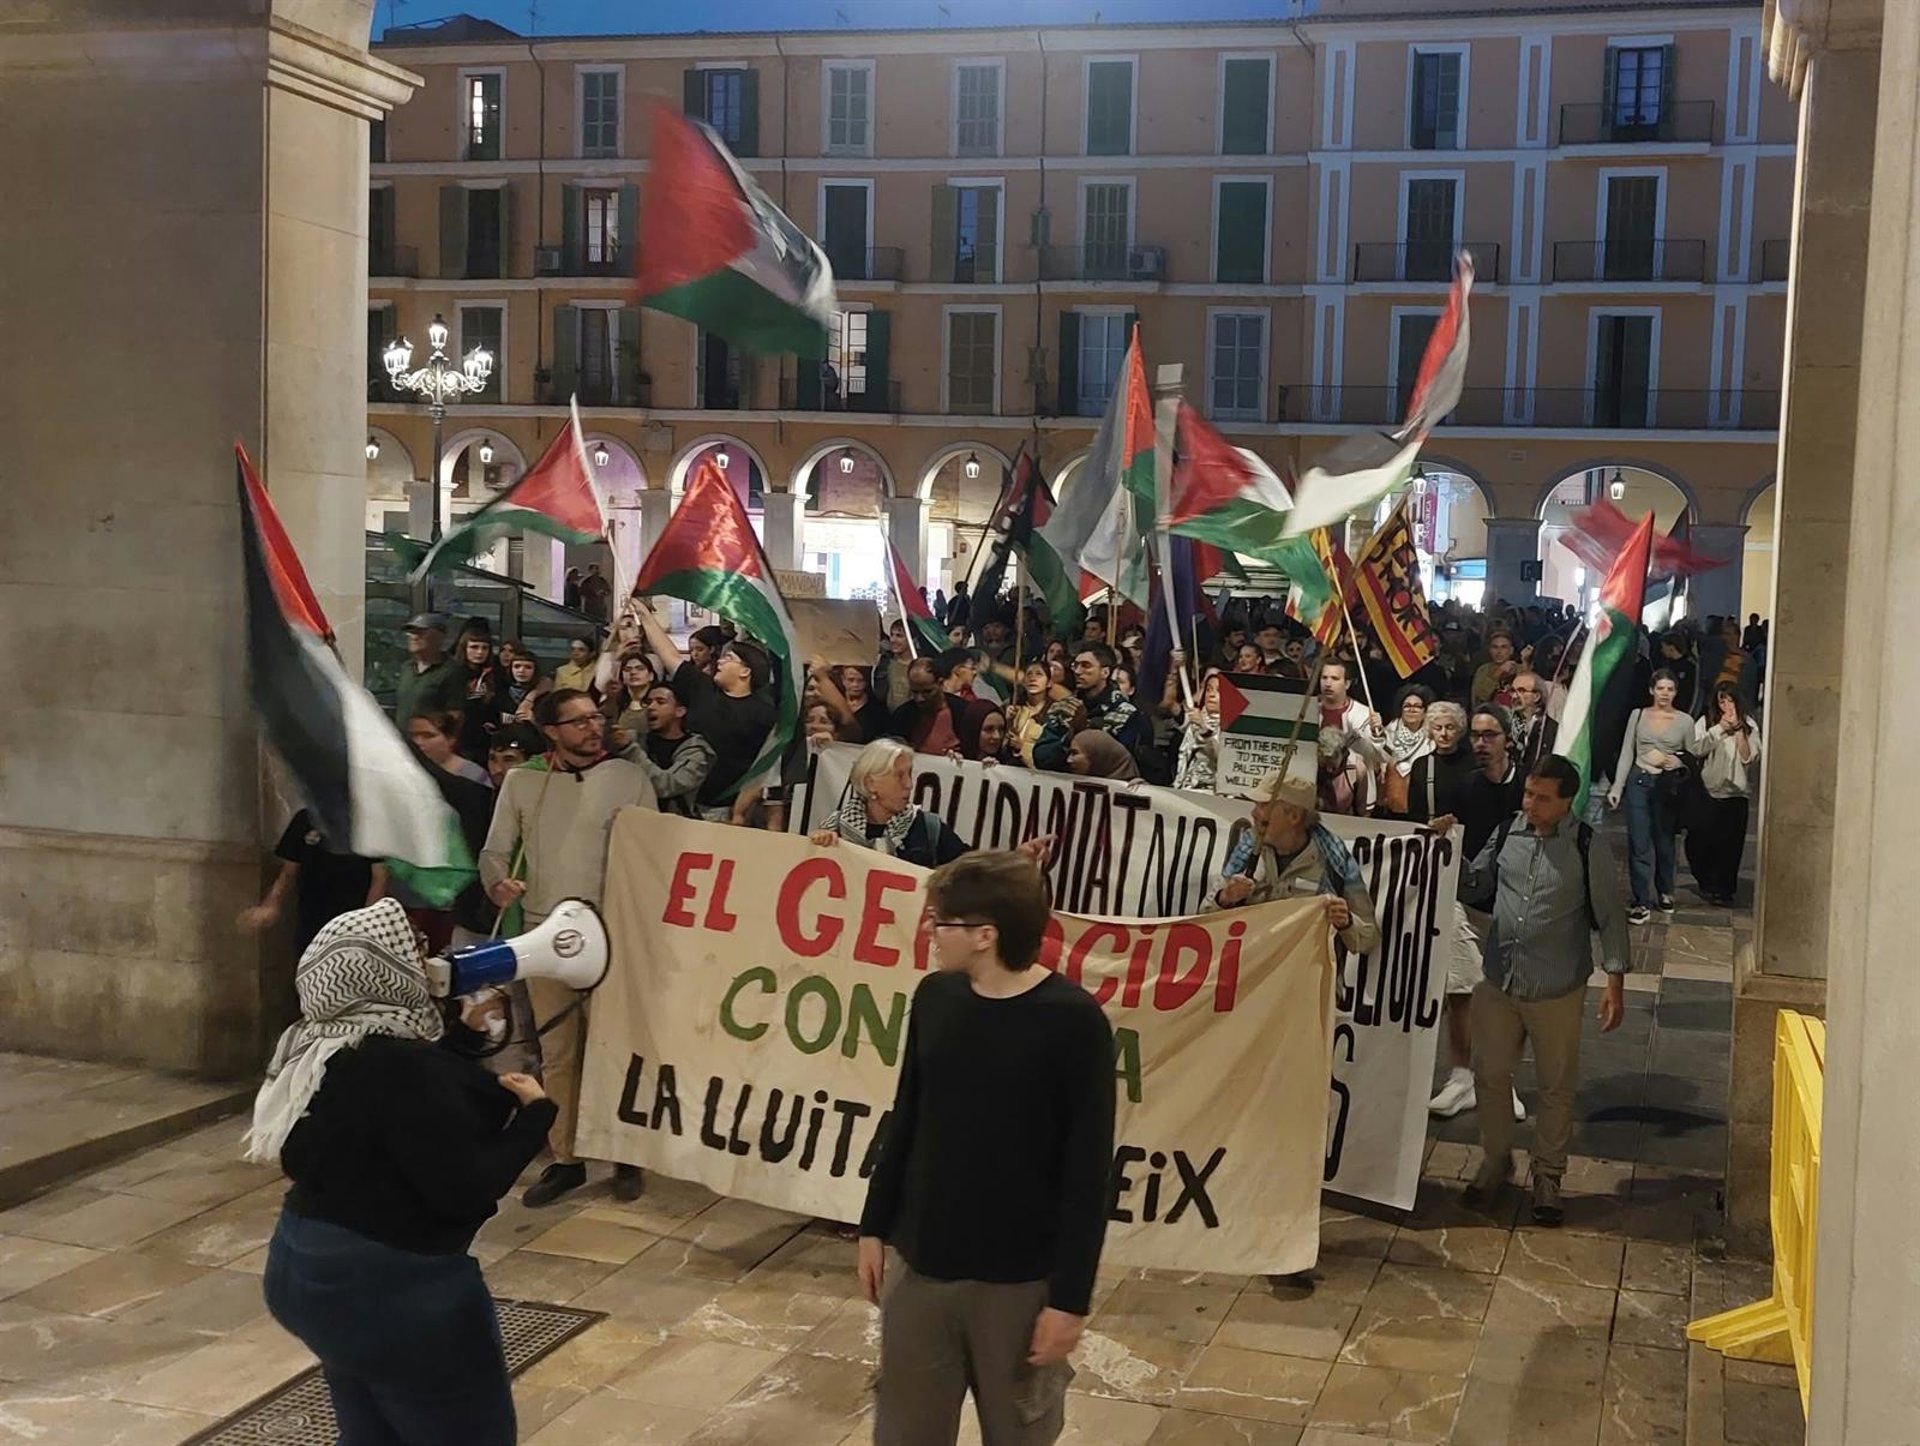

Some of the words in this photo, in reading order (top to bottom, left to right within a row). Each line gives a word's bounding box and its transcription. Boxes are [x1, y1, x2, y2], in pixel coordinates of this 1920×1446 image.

[1224, 738, 1250, 750] FROM
[1251, 740, 1270, 752] THE
[1233, 761, 1282, 776] PALEST
[1236, 750, 1249, 762] TO
[1251, 753, 1270, 765] THE
[1138, 813, 1217, 918] NO
[662, 852, 738, 932] EL
[776, 857, 1248, 1013] GECiDi
[1335, 827, 1453, 1033] ELICTE
[618, 1052, 682, 1136] LA
